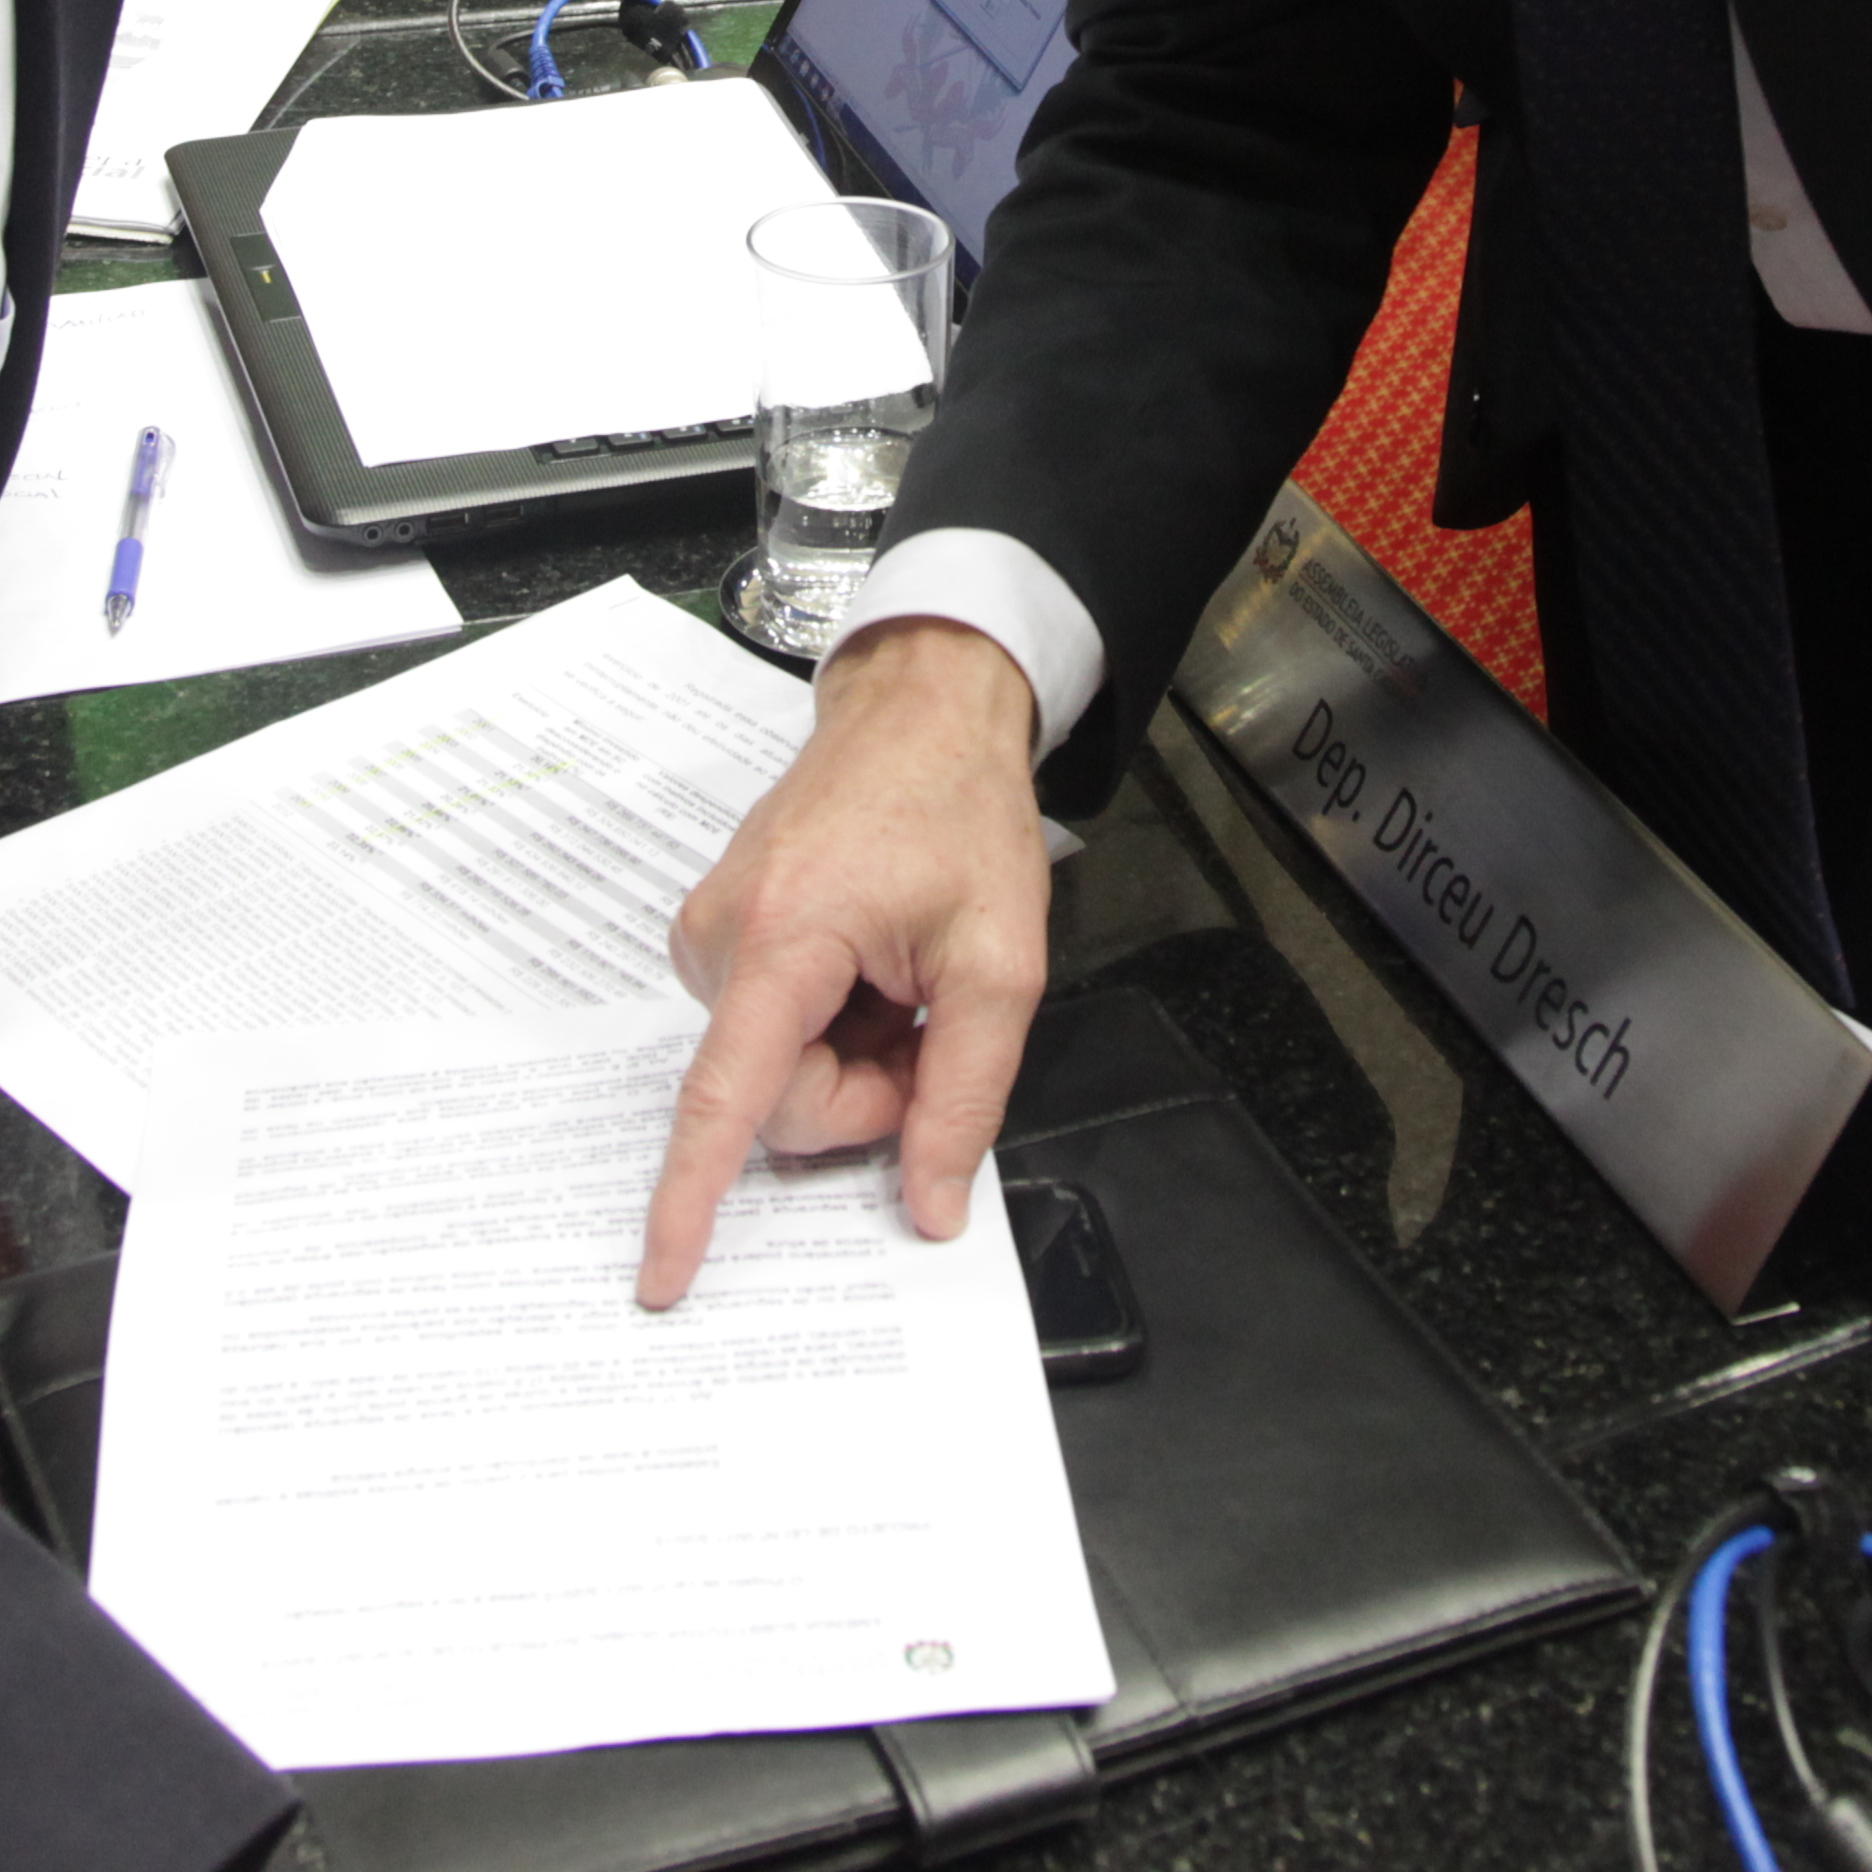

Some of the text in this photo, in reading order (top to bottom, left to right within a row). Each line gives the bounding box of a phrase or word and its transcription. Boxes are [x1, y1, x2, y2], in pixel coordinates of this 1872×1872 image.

[1302, 559, 1365, 627] ASSEMBLEIA
[1292, 698, 1633, 1101] Dep. Dirceu Dresch
